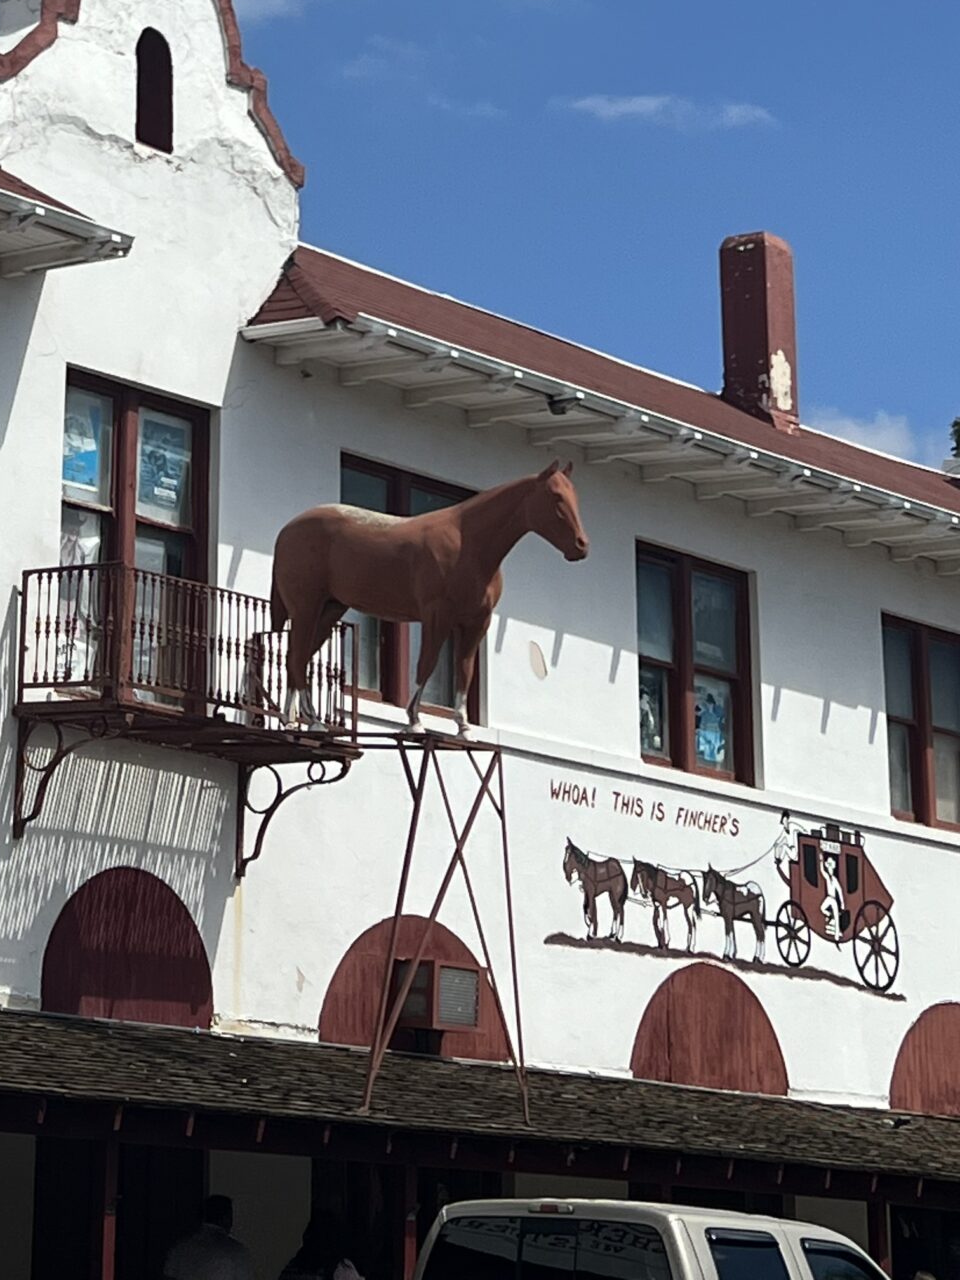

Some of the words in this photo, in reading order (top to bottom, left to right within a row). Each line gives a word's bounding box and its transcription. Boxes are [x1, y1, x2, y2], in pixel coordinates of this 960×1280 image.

[550, 779, 596, 808] WHOA!
[612, 791, 644, 817] THIS
[650, 801, 665, 821] IS
[675, 807, 740, 837] FINCHER'S
